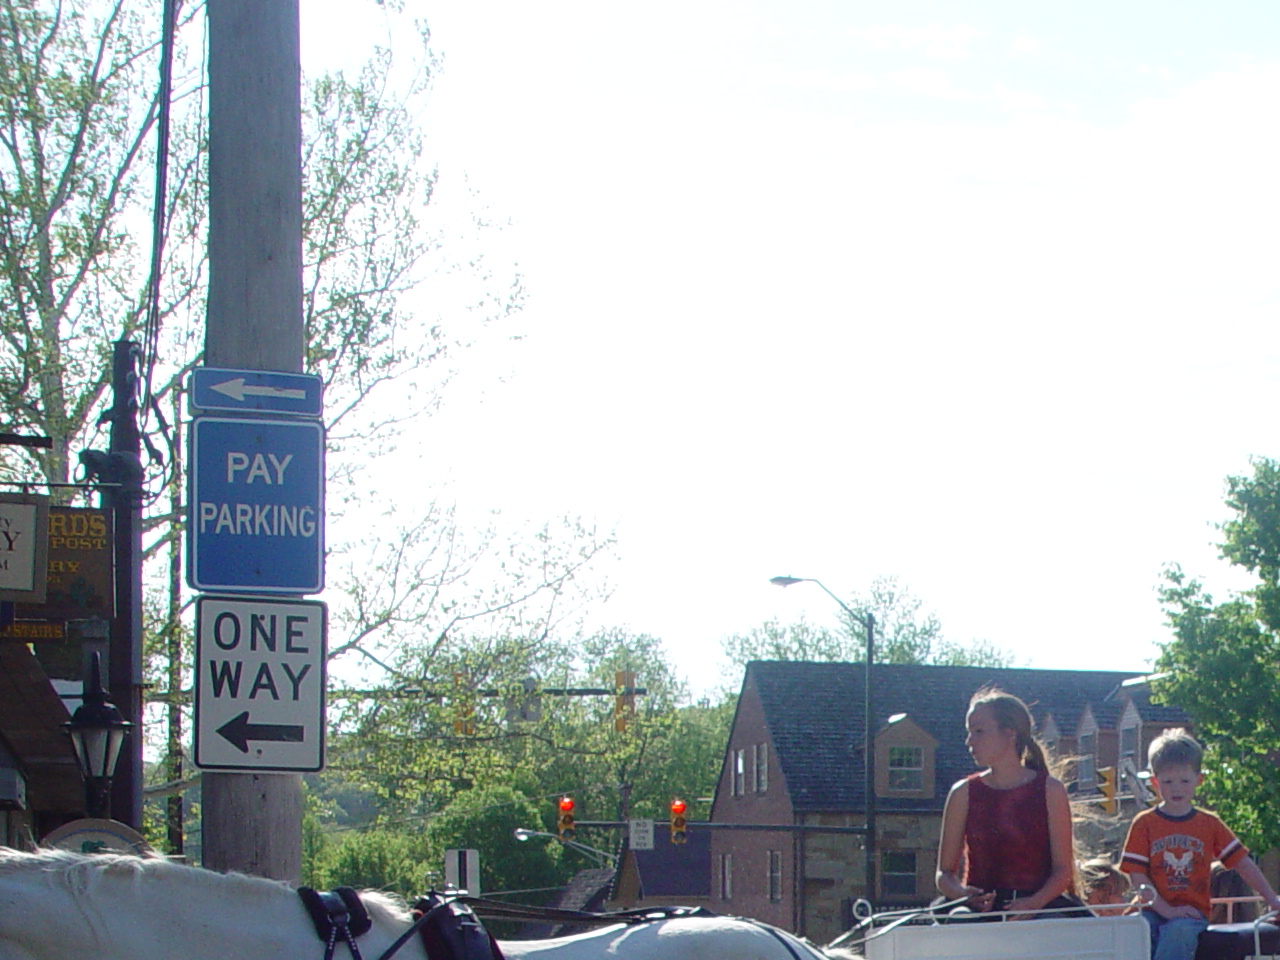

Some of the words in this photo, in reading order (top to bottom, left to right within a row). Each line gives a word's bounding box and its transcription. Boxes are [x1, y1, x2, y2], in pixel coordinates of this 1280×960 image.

[227, 452, 293, 484] PAY
[49, 513, 107, 536] RD'S
[200, 502, 316, 537] PARKING
[51, 537, 107, 550] POST
[48, 560, 81, 573] RY
[0, 625, 63, 638] STAIRS
[213, 612, 309, 653] ONE
[209, 660, 312, 701] WAY
